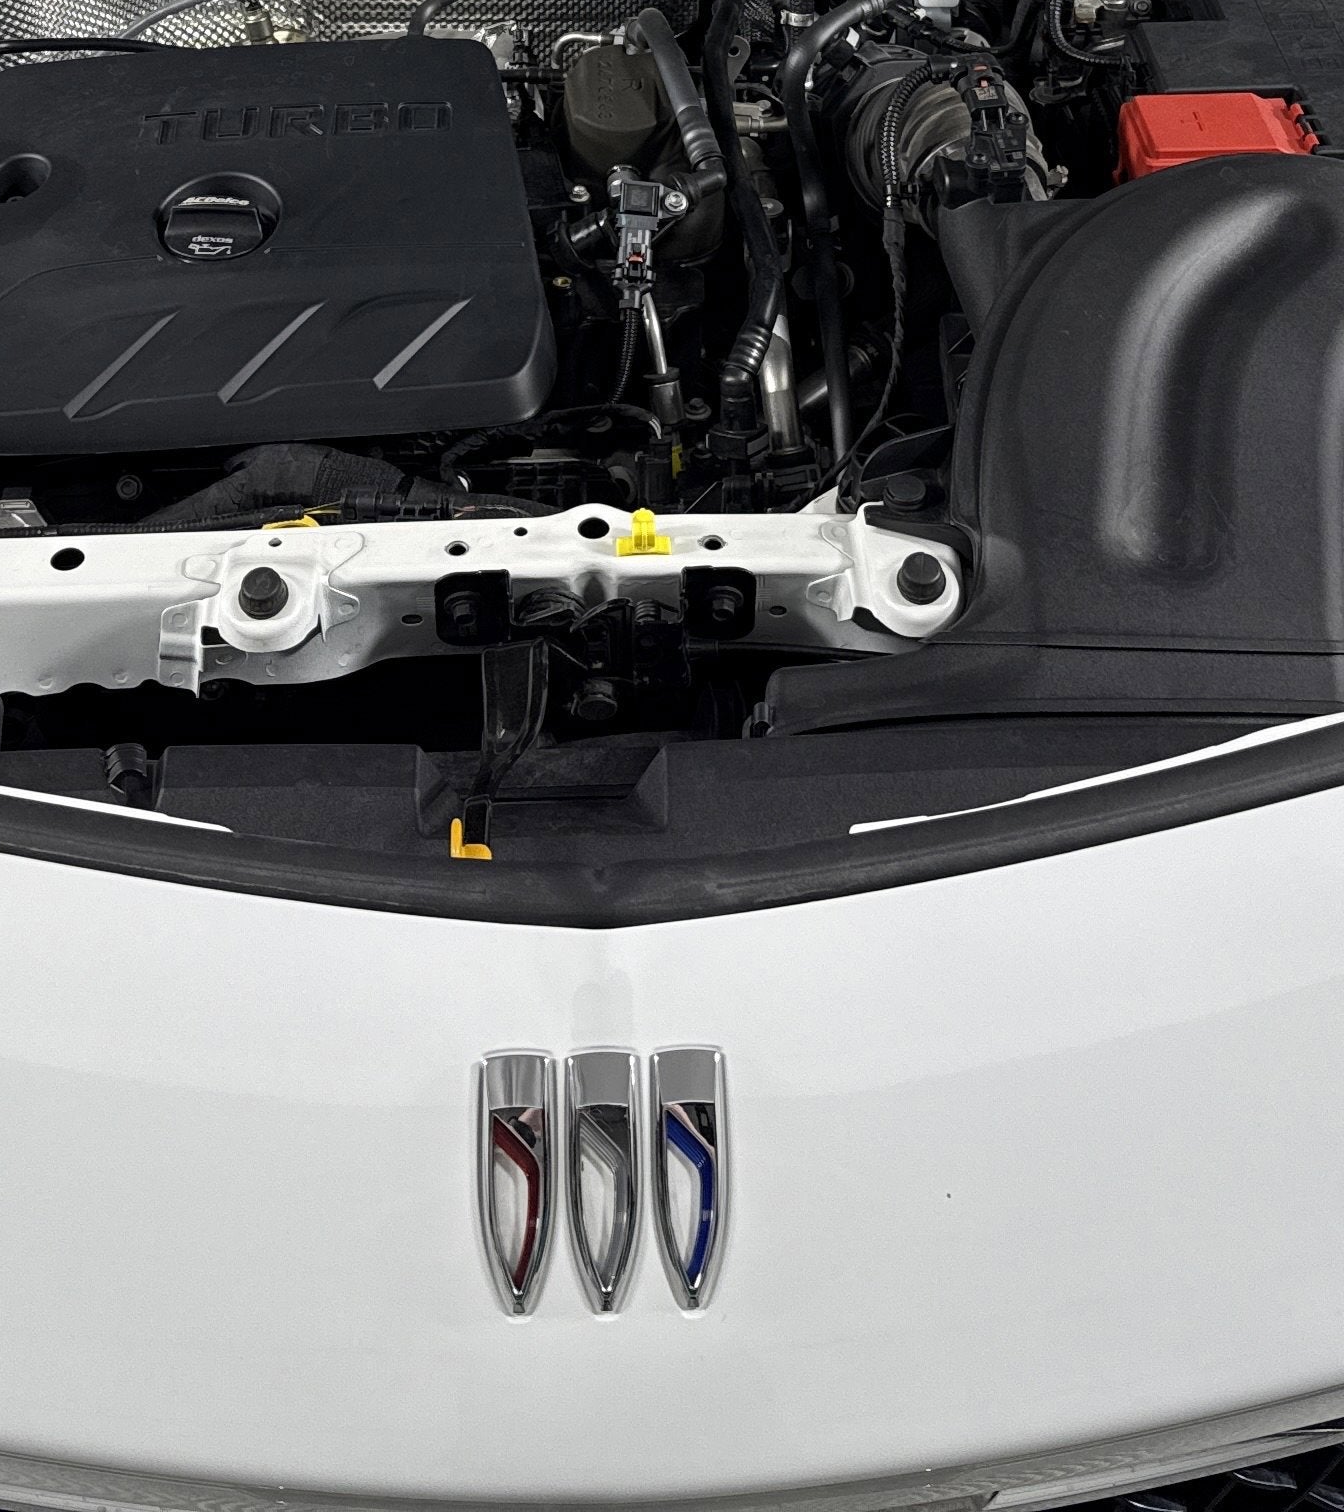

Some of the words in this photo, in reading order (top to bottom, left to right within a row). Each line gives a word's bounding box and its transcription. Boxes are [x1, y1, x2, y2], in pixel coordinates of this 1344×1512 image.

[141, 100, 455, 146] TURBO
[179, 196, 250, 206] ACDelco
[191, 235, 234, 244] dexos
